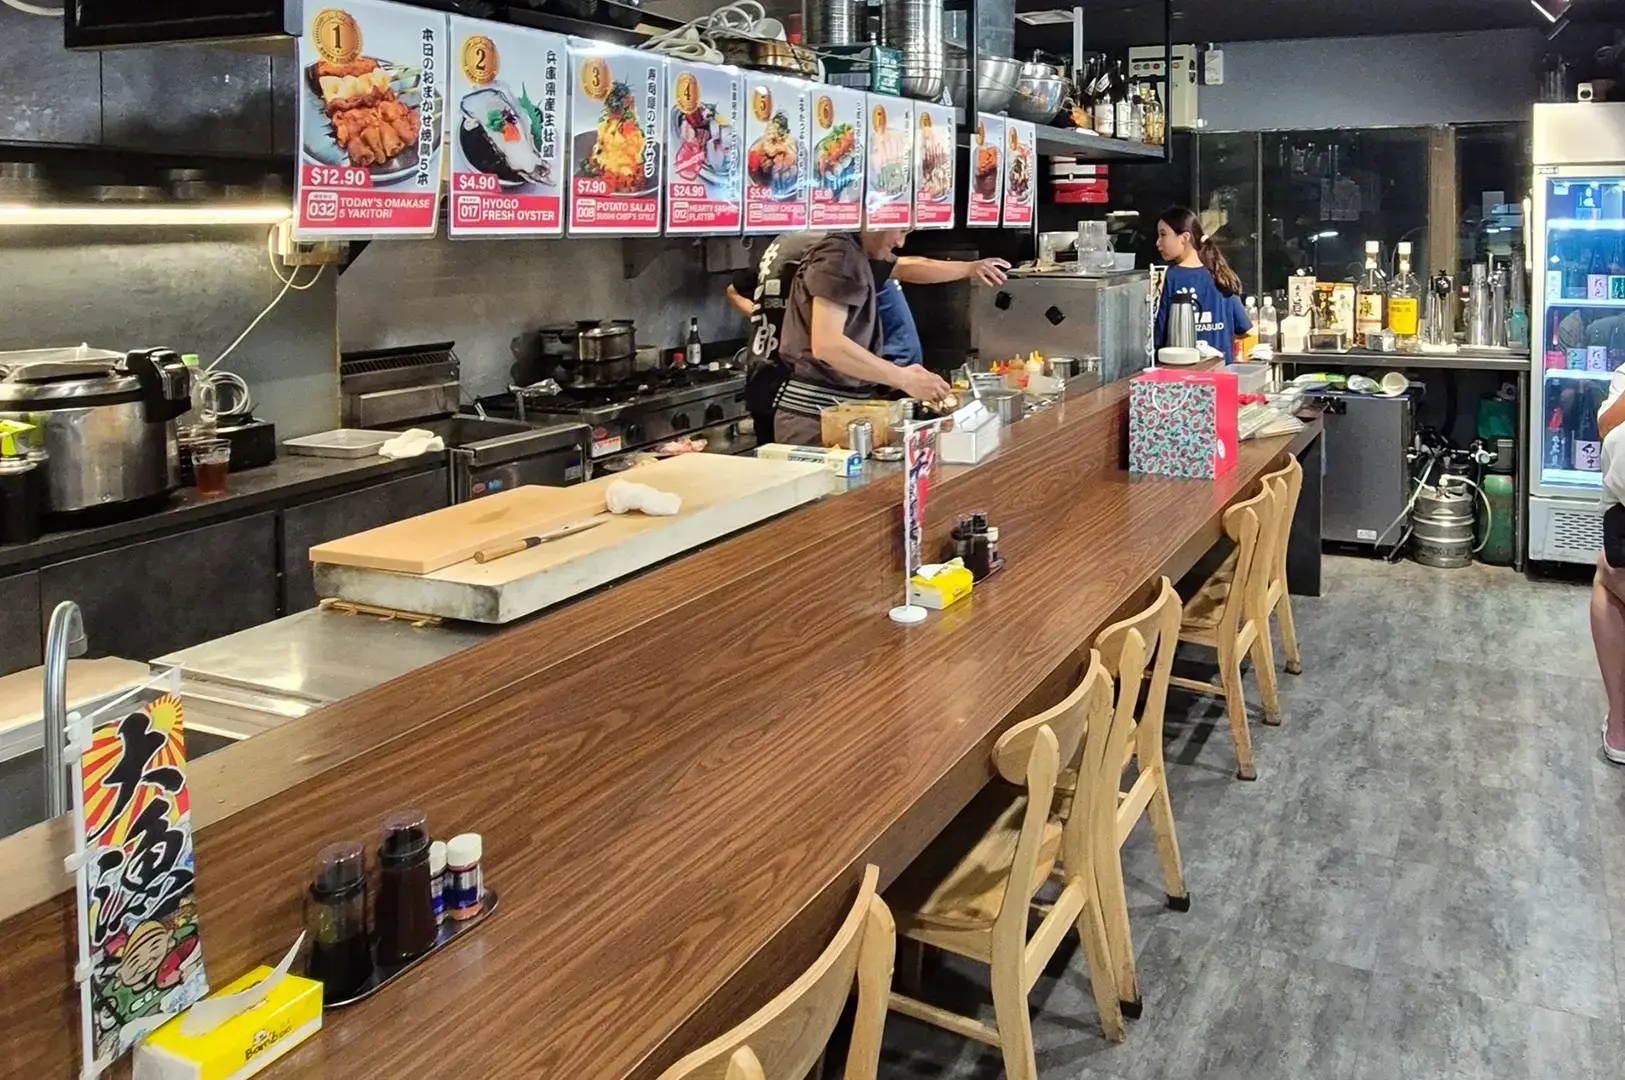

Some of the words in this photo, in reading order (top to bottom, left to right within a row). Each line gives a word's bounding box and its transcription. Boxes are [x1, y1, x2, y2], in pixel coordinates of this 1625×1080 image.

[332, 25, 342, 49] 1
[476, 48, 486, 71] 2
[592, 67, 600, 87] 3
[683, 82, 691, 101] 4
[311, 167, 366, 186] $12.90
[459, 174, 496, 190] $4.90
[577, 180, 607, 194] $7.90
[673, 184, 704, 197] $24.90
[309, 202, 336, 217] 032
[340, 197, 383, 208] TODAY'S
[384, 198, 431, 209] OMAKASE
[482, 199, 519, 209] HYOGO
[596, 202, 629, 212] POTATO
[629, 203, 656, 213] SALAD
[339, 209, 345, 218] 5
[348, 208, 393, 219] YAKITORI
[461, 205, 479, 218] 017
[482, 210, 514, 221] FRESH
[517, 211, 554, 221] OYSTER
